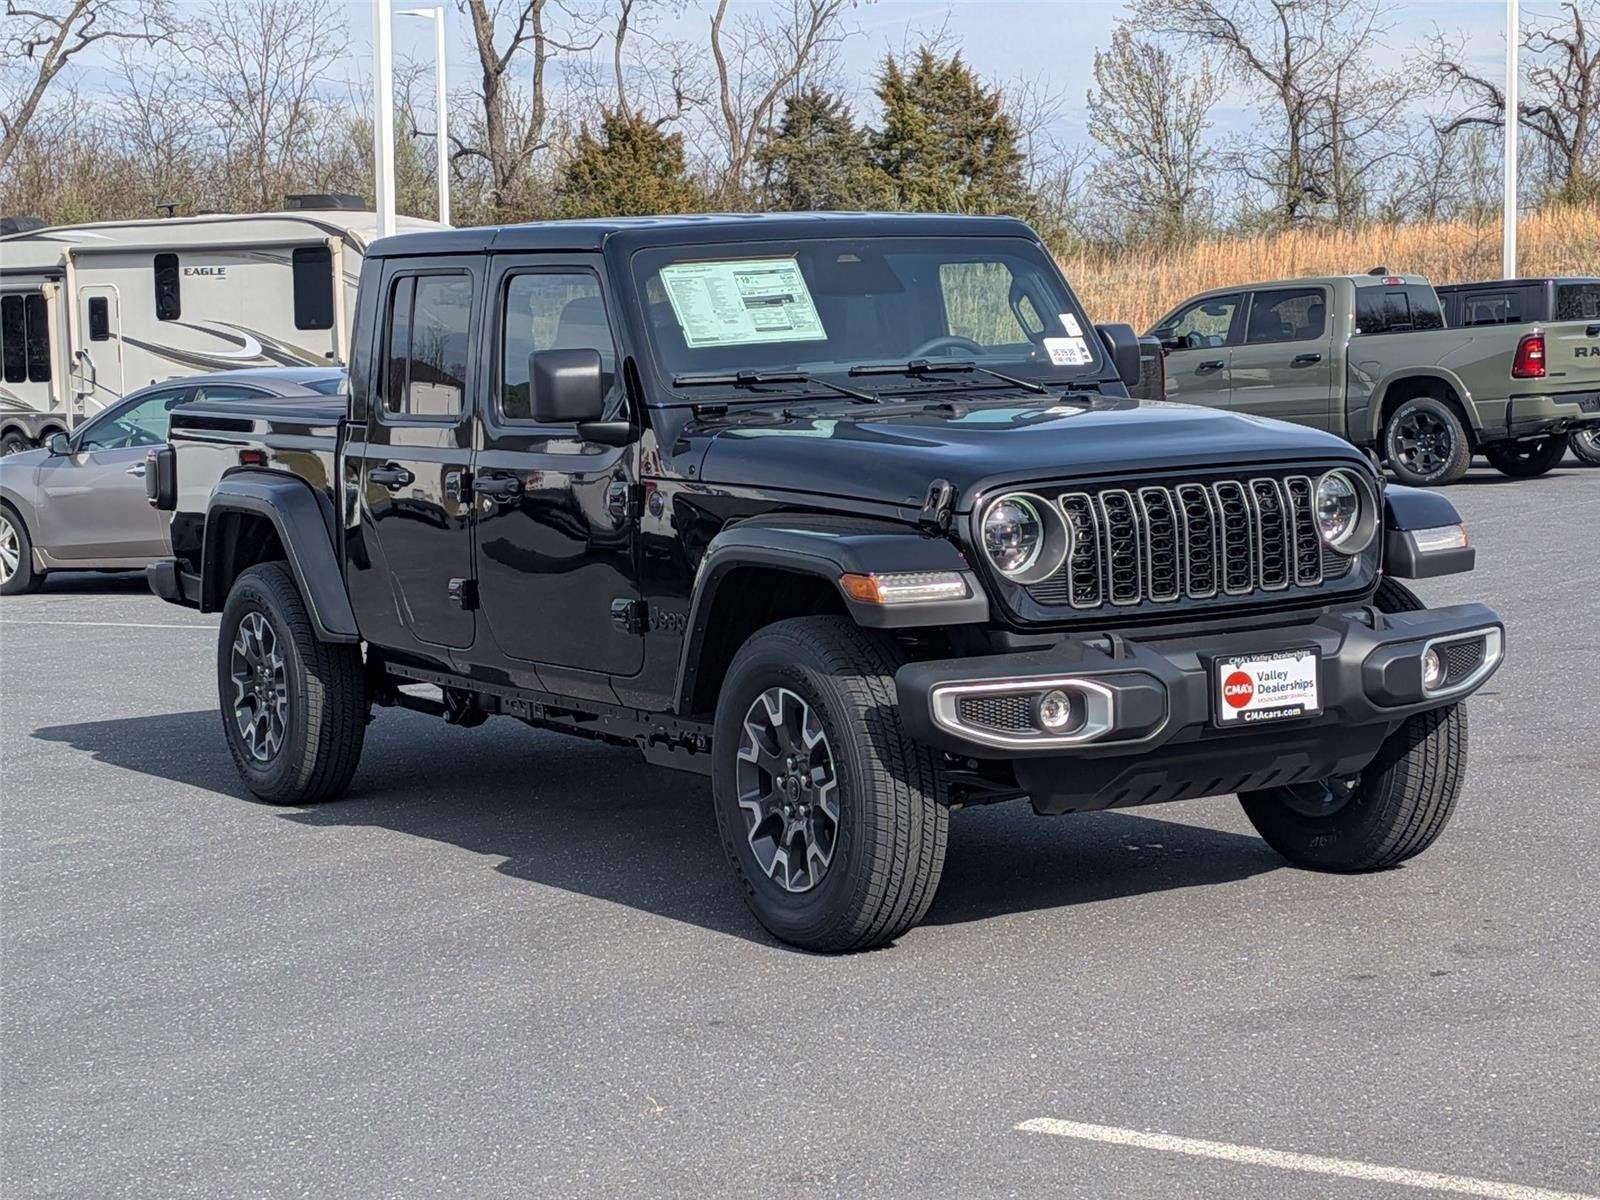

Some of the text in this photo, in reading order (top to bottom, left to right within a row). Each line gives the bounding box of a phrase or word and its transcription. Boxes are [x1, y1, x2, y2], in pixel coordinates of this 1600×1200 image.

[184, 267, 226, 276] EAGLE
[1229, 650, 1311, 665] CMA's Valley Dealerships
[1257, 670, 1288, 682] Valley
[1225, 683, 1252, 696] CMA's
[1258, 679, 1314, 694] Dealerships
[1244, 708, 1301, 721] CMAcars.com
